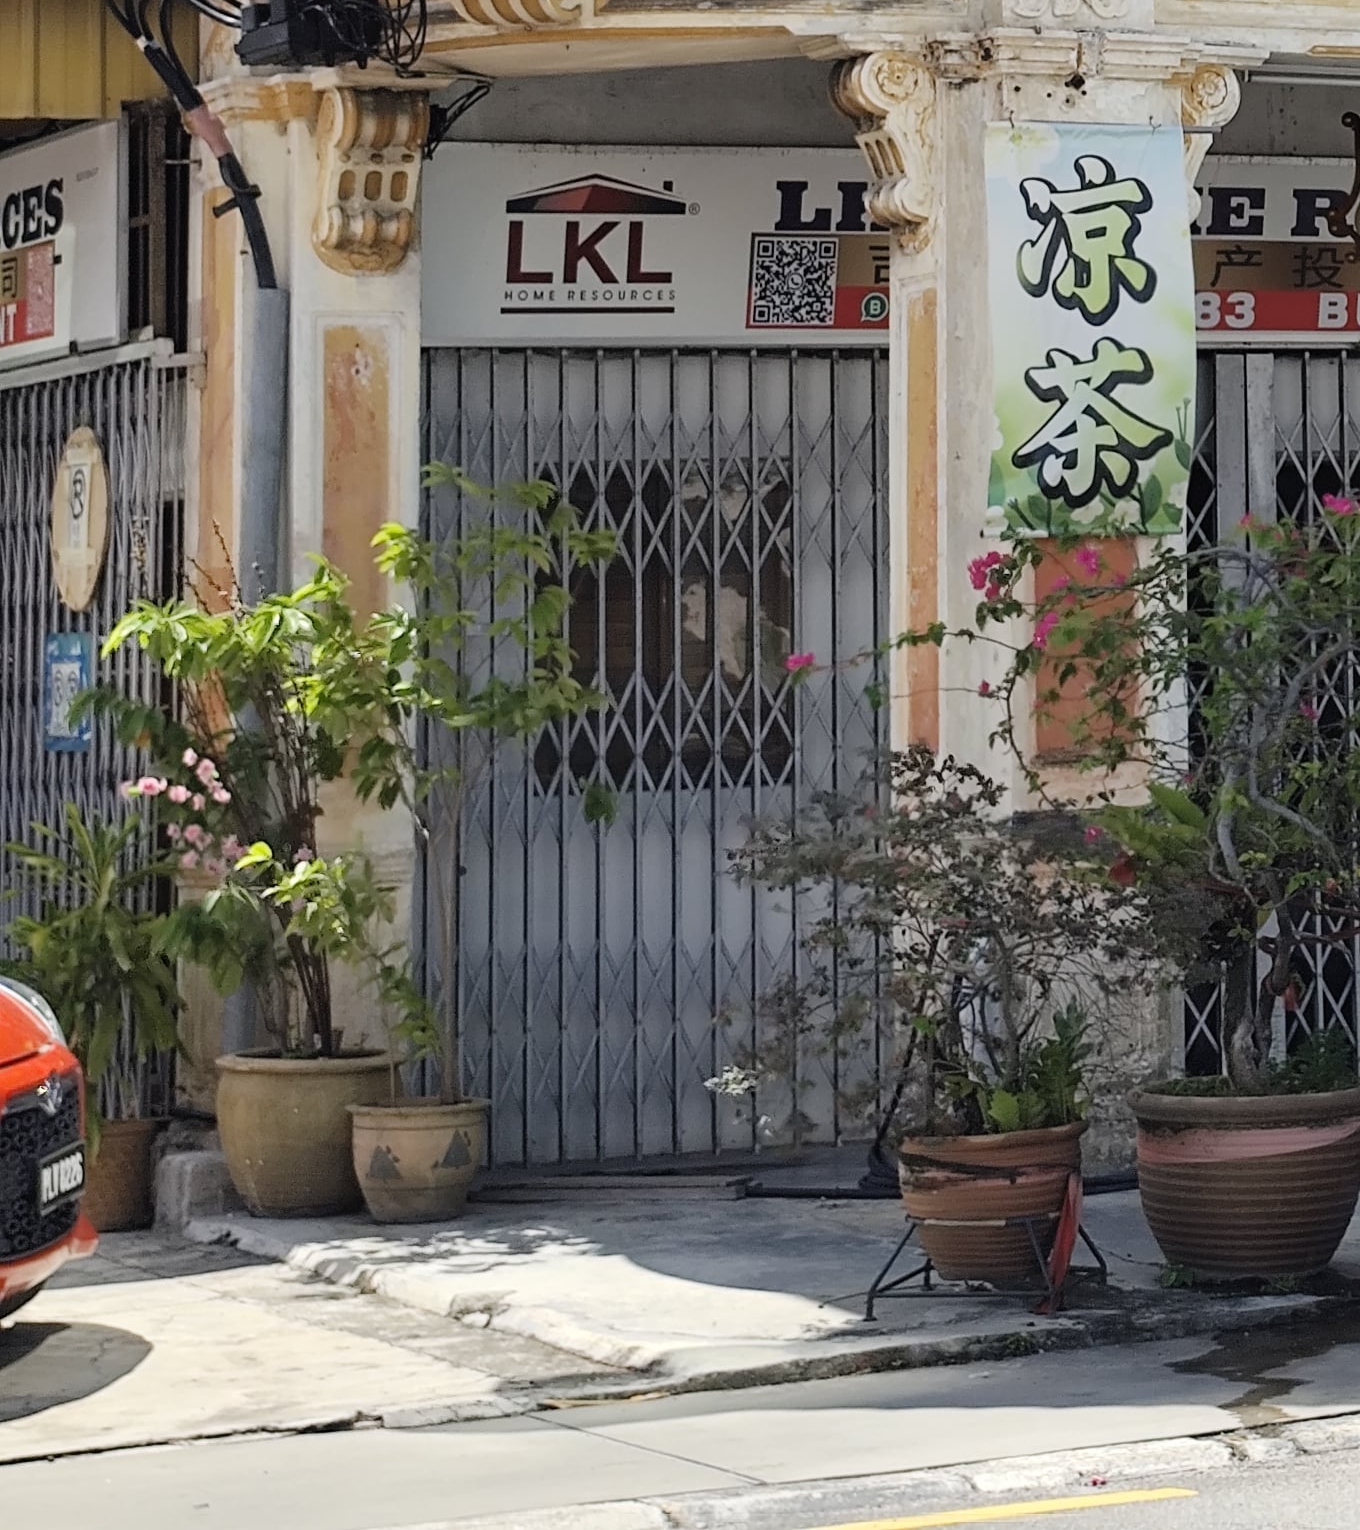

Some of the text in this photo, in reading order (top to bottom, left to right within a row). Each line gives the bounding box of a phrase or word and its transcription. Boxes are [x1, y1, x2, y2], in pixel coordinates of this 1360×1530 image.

[506, 221, 672, 284] LKL
[504, 290, 676, 301] HOME RESOURCES
[1012, 154, 1174, 509] 凉茶
